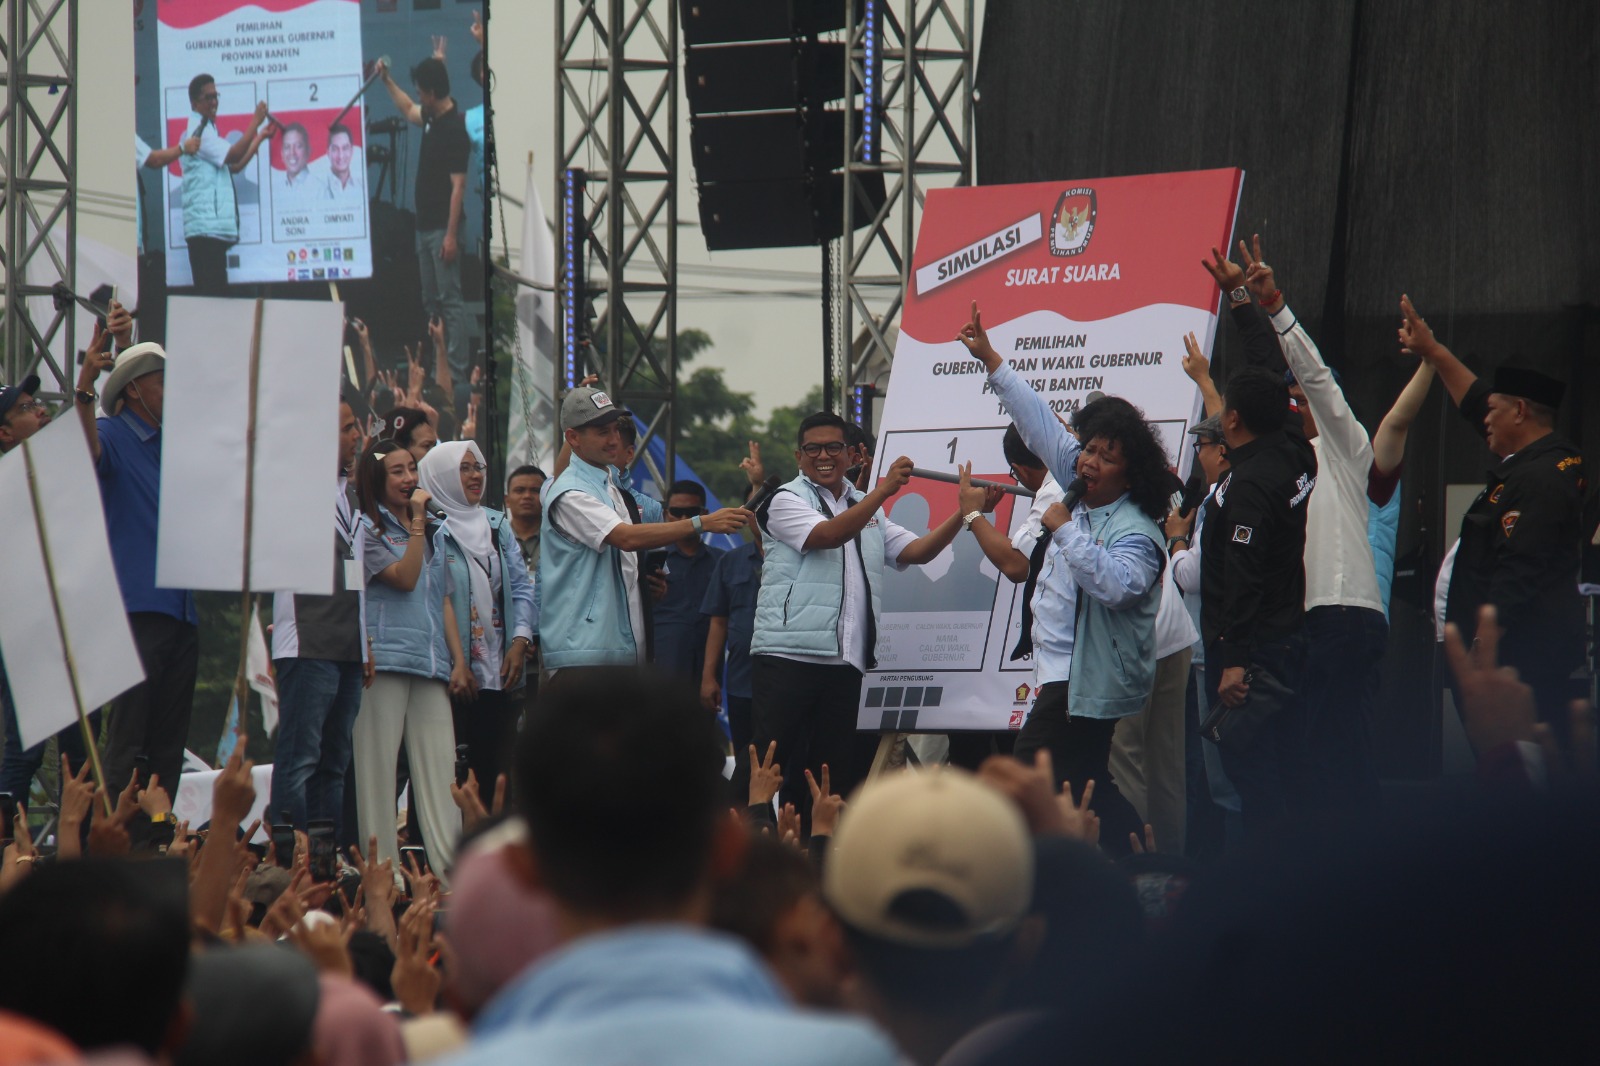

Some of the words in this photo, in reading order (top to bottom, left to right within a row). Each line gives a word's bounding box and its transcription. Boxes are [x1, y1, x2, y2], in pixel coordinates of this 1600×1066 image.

[236, 21, 283, 33] PEMILIHAN
[185, 38, 231, 51] GUBERNUR
[234, 36, 254, 47] DAN
[256, 34, 285, 45] WAKIL
[288, 31, 335, 43] GUBERNUR
[221, 50, 262, 62] PROVINSI
[265, 48, 300, 60] BANTEN
[234, 65, 265, 76] TAHUN
[308, 83, 319, 102] 2
[1065, 188, 1092, 197] KOMISI
[281, 216, 309, 226] ANDRA
[1050, 227, 1076, 256] PEMILIHAN
[1078, 224, 1094, 253] UMUM
[937, 226, 1021, 281] SIMULASI
[1005, 266, 1060, 287] SURAT
[1062, 263, 1120, 283] SUARA
[1015, 334, 1087, 351] PEMILIHAN
[932, 360, 990, 376] GUBERN
[1041, 356, 1085, 371] WAKIL
[1089, 352, 1163, 368] GUBERNUR
[1049, 376, 1104, 392] BANTEN
[1048, 399, 1080, 414] 2024
[946, 436, 958, 464] 1
[953, 622, 983, 630] GUBERNUR
[936, 634, 958, 642] NAMA
[919, 644, 946, 653] CALON
[947, 643, 971, 652] WAKIL
[921, 653, 965, 662] GUBERNUR
